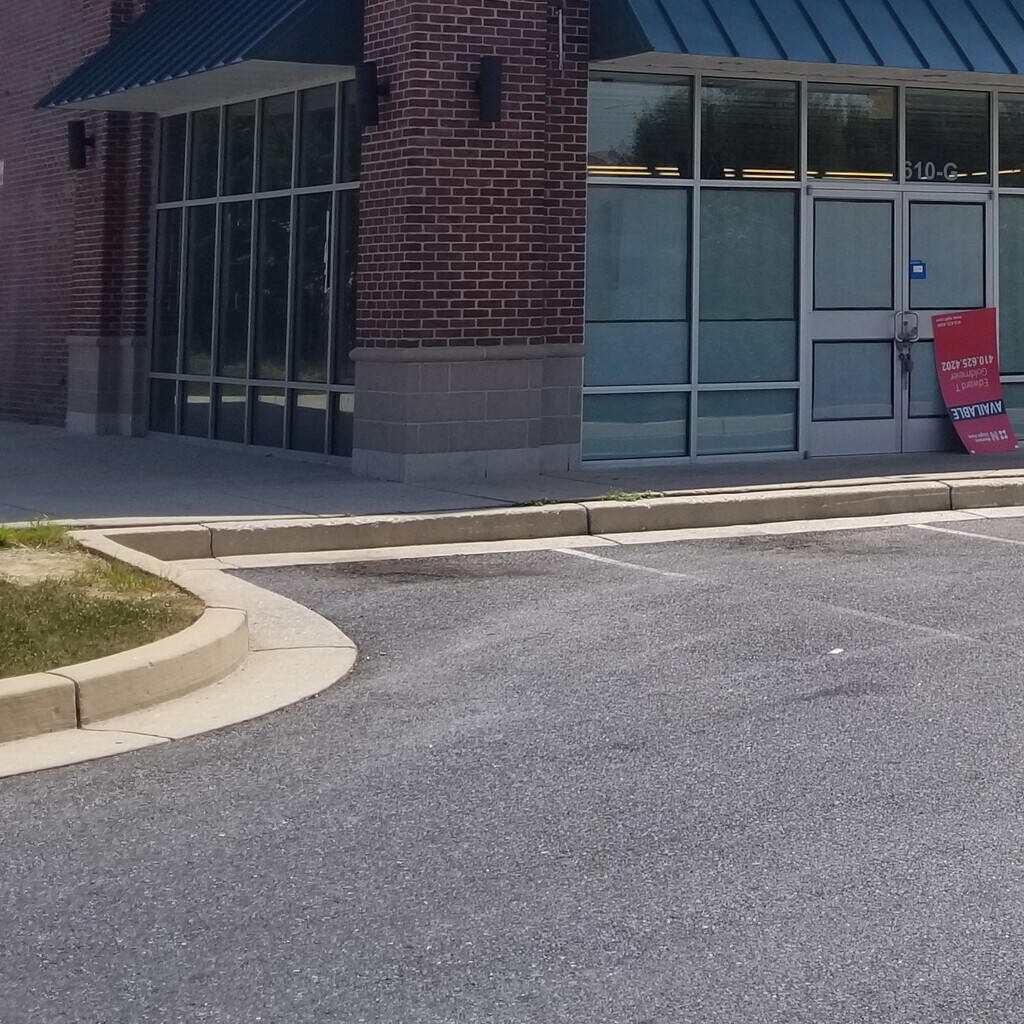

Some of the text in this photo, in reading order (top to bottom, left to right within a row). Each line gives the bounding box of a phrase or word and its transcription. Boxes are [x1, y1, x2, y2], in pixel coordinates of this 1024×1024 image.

[905, 160, 958, 182] 610-G
[941, 354, 994, 372] 410.625.4202
[961, 378, 989, 391] Edward
[950, 400, 1002, 420] AVAILABLE
